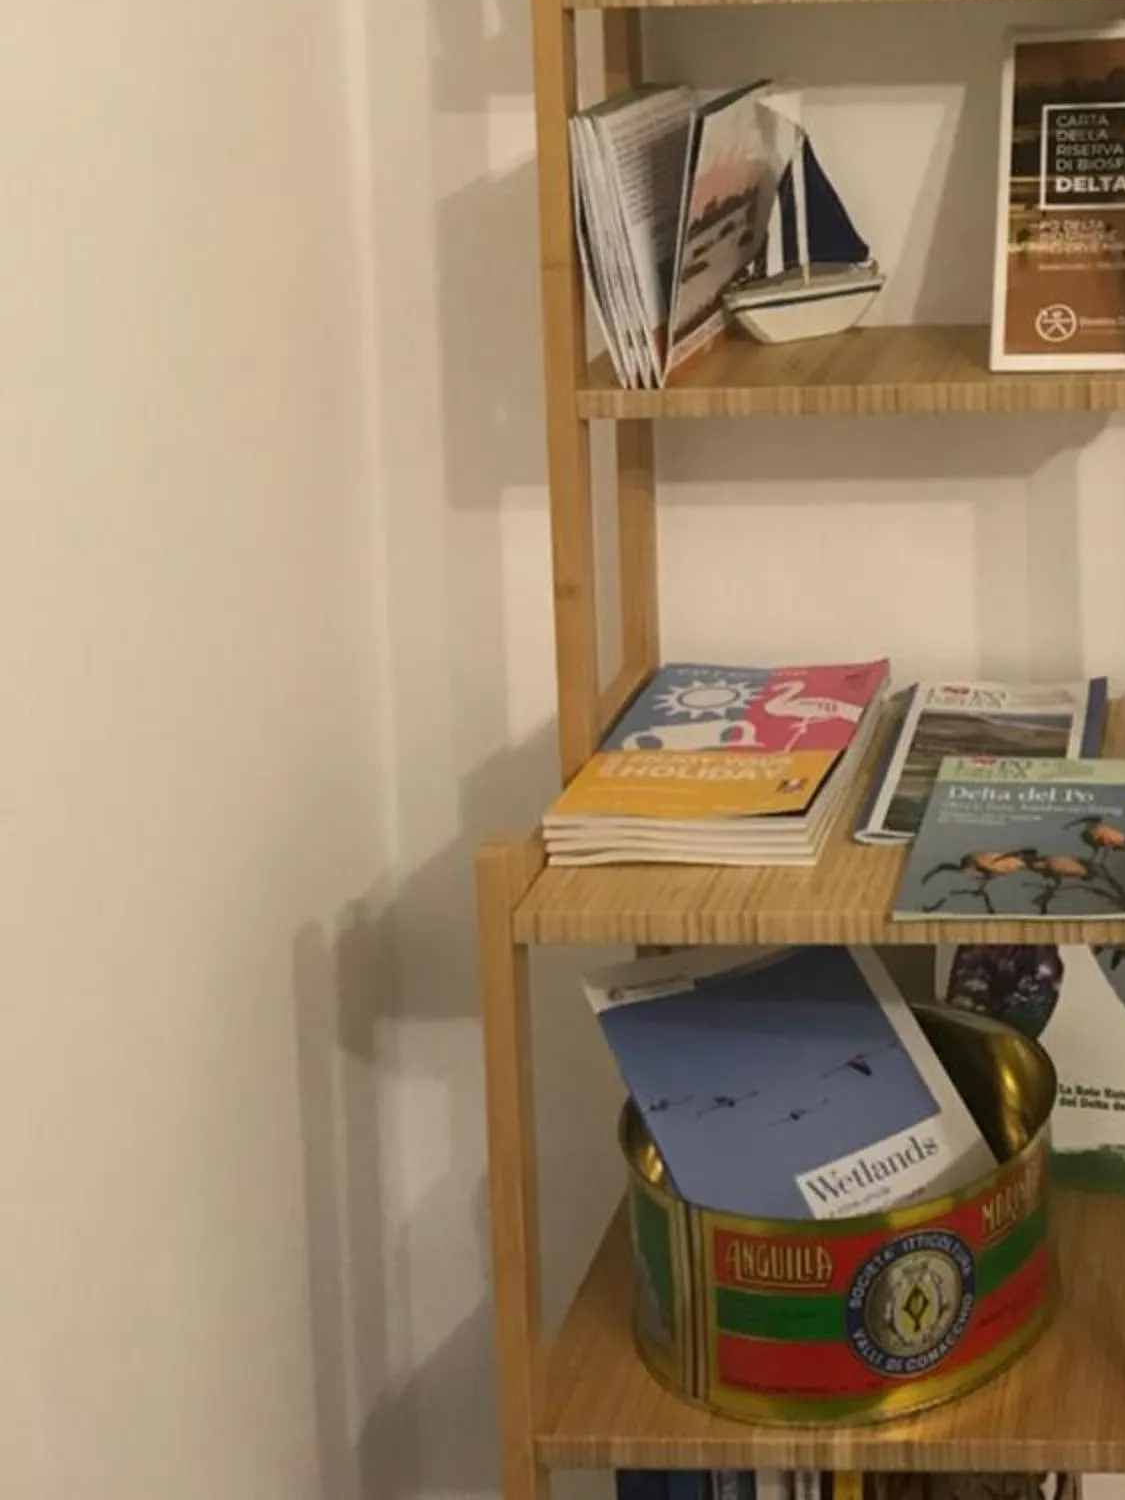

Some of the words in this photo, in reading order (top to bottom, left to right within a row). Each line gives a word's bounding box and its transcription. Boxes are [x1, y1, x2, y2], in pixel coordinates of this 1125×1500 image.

[1056, 114, 1109, 127] CARTA
[1056, 129, 1108, 142] DELLA
[1056, 143, 1124, 156] RISERVA
[1056, 158, 1073, 171] DI
[619, 764, 784, 781] HOLIDAY
[949, 784, 1011, 801] Delta
[1018, 786, 1056, 802] del
[1065, 787, 1095, 802] Po
[805, 1135, 939, 1202] Wetlands
[725, 1240, 833, 1281] ANGUILLA
